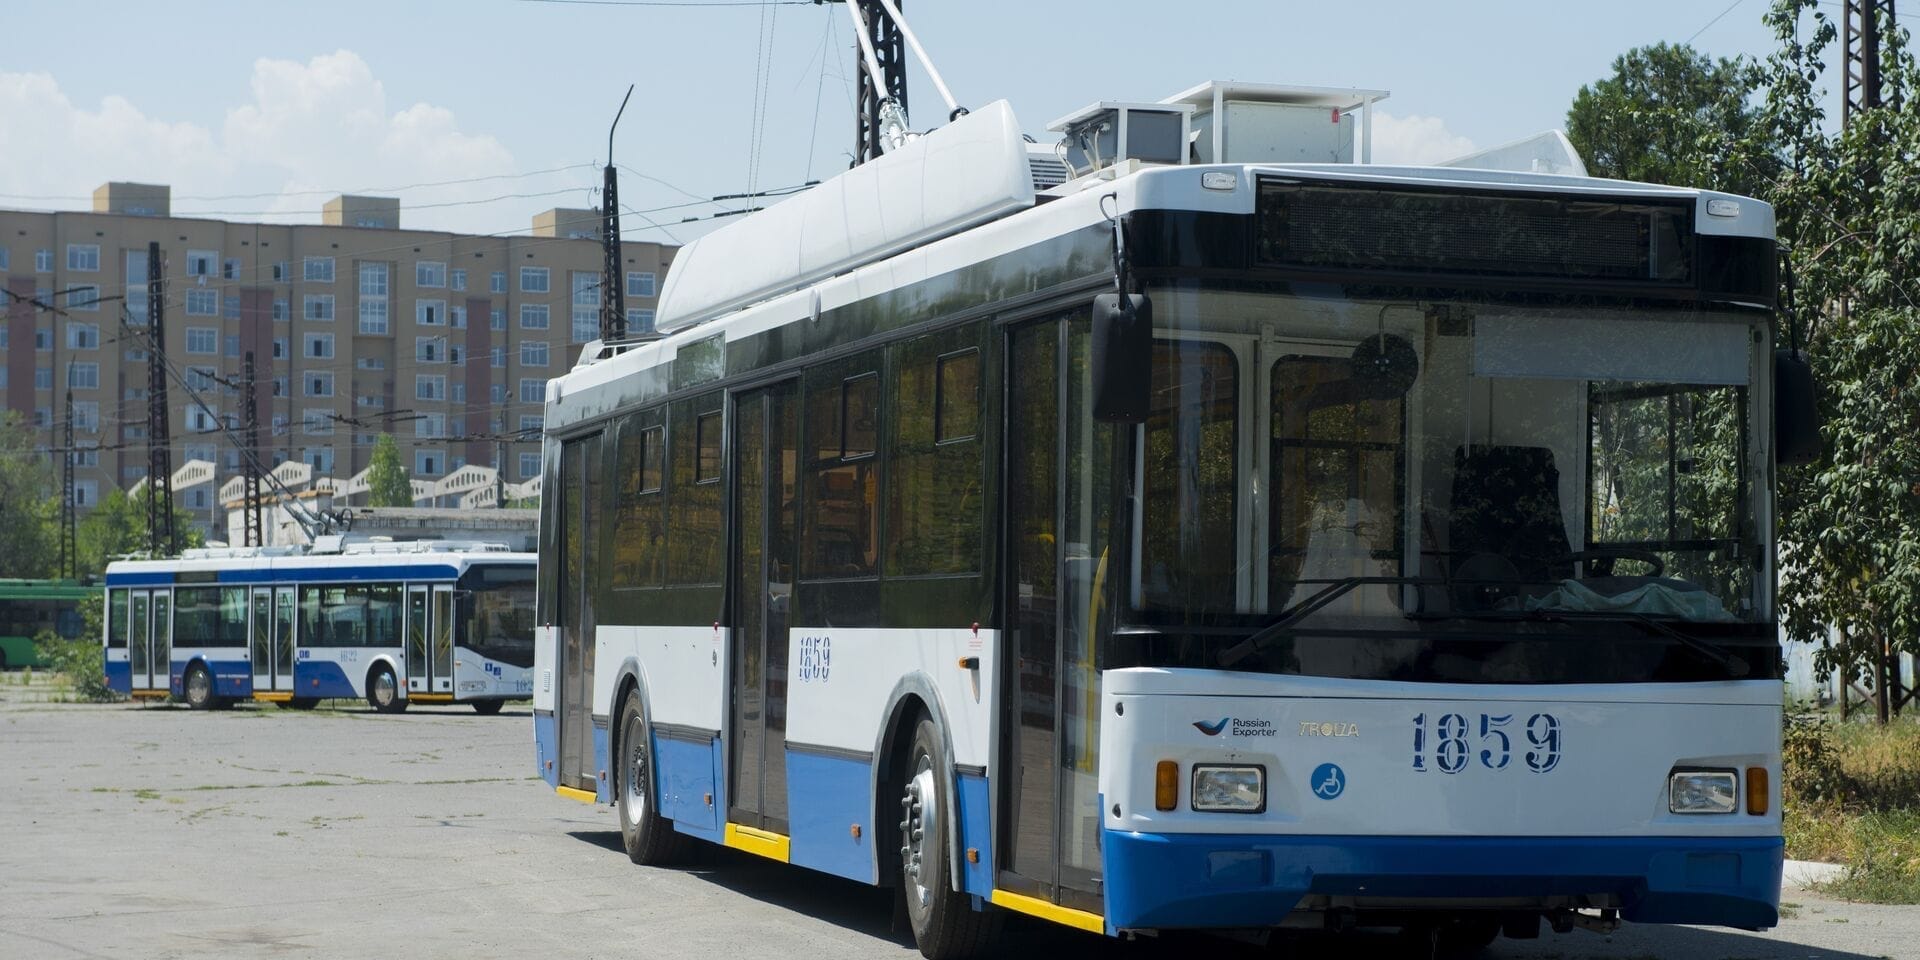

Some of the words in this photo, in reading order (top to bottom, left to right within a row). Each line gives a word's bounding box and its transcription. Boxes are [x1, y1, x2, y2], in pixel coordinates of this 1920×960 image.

[799, 637, 830, 682] 1859
[1233, 718, 1271, 727] Russian
[1299, 722, 1359, 737] TROLZA
[1233, 728, 1277, 737] Exporter
[1413, 713, 1560, 774] 1859
